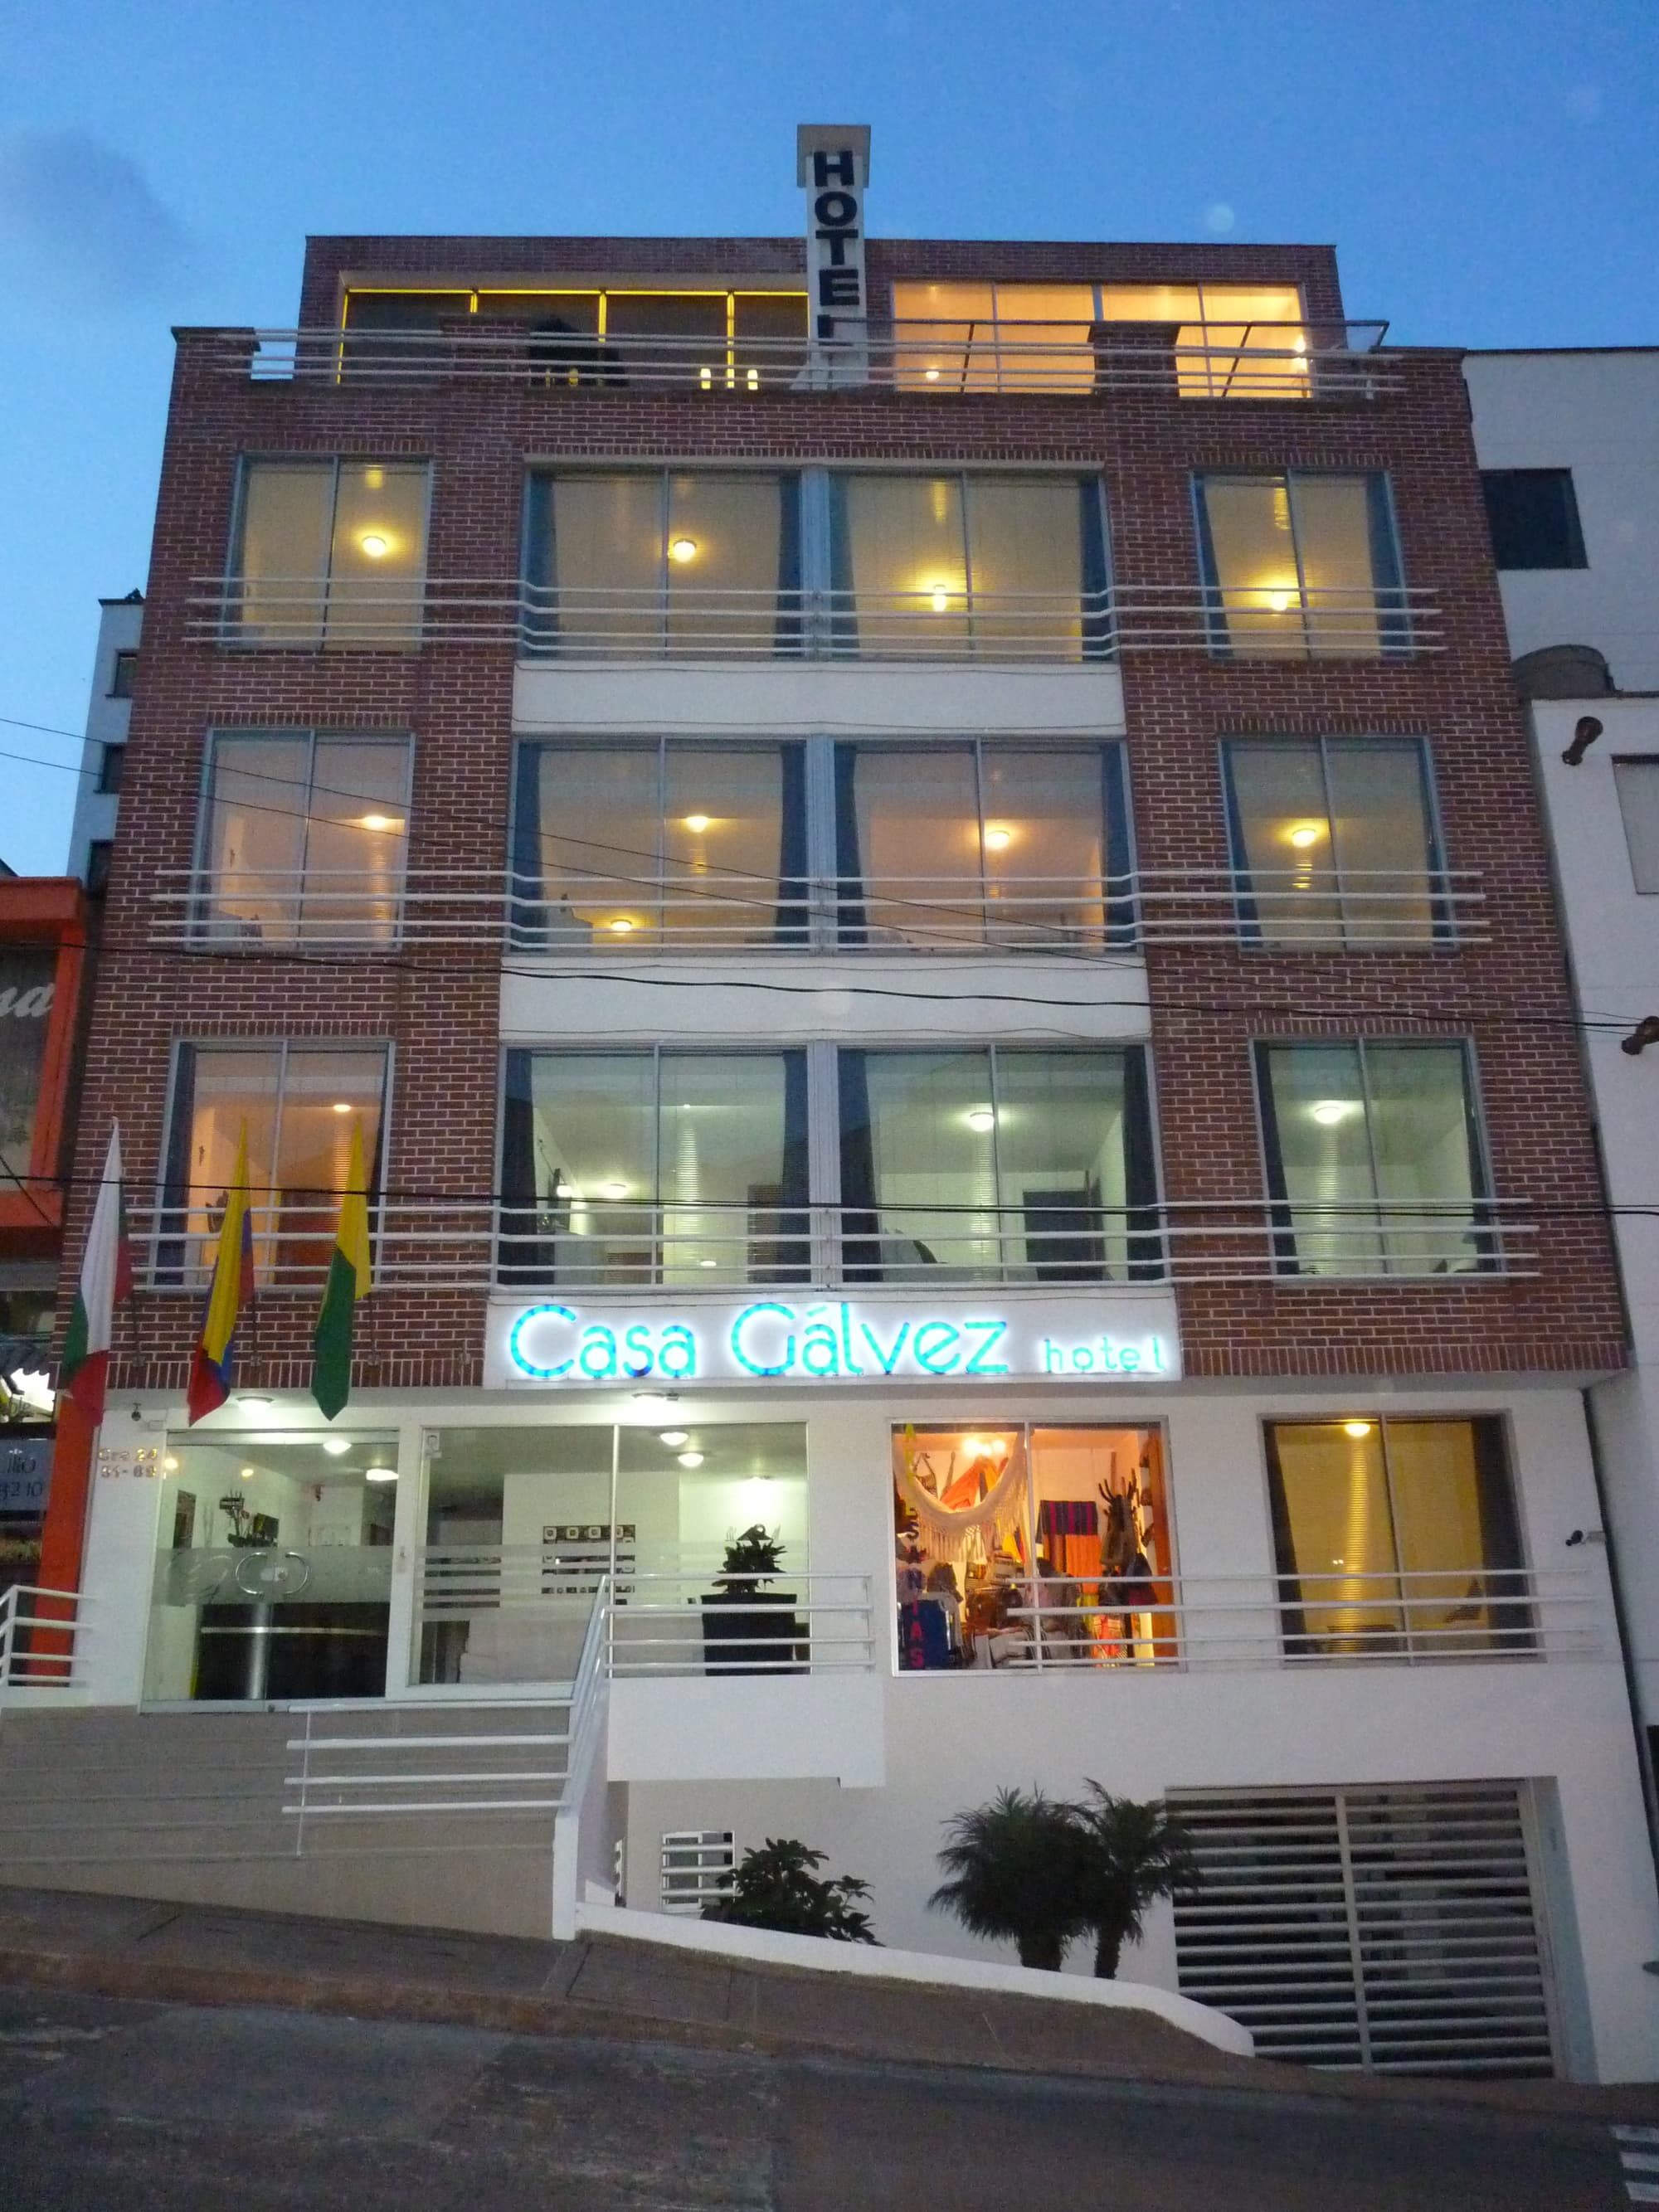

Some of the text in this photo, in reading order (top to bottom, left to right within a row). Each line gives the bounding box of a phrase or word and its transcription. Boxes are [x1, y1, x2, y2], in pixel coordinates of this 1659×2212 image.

[814, 150, 859, 346] HOTEL
[510, 1302, 1165, 1378] Casa Gálvez hotel
